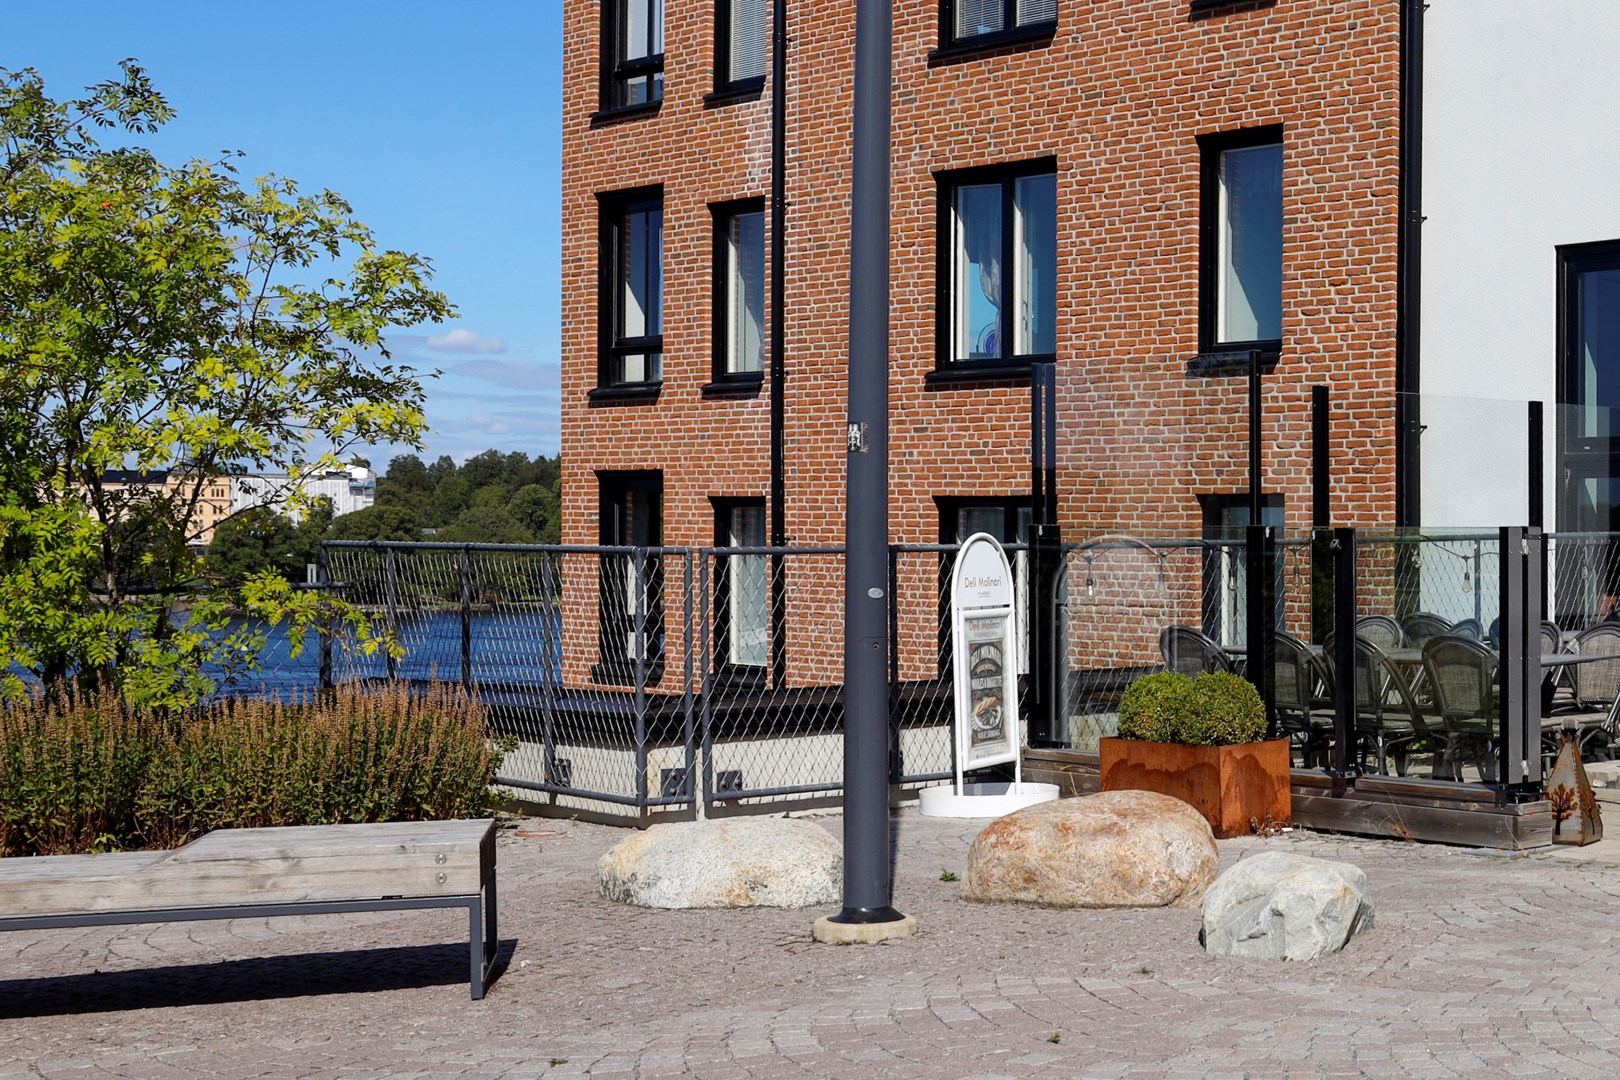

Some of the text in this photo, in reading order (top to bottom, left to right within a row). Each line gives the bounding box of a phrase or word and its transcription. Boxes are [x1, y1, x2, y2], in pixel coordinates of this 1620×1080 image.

[964, 576, 1002, 588] Deli Molinari
[968, 619, 1003, 631] Deli Molinari
